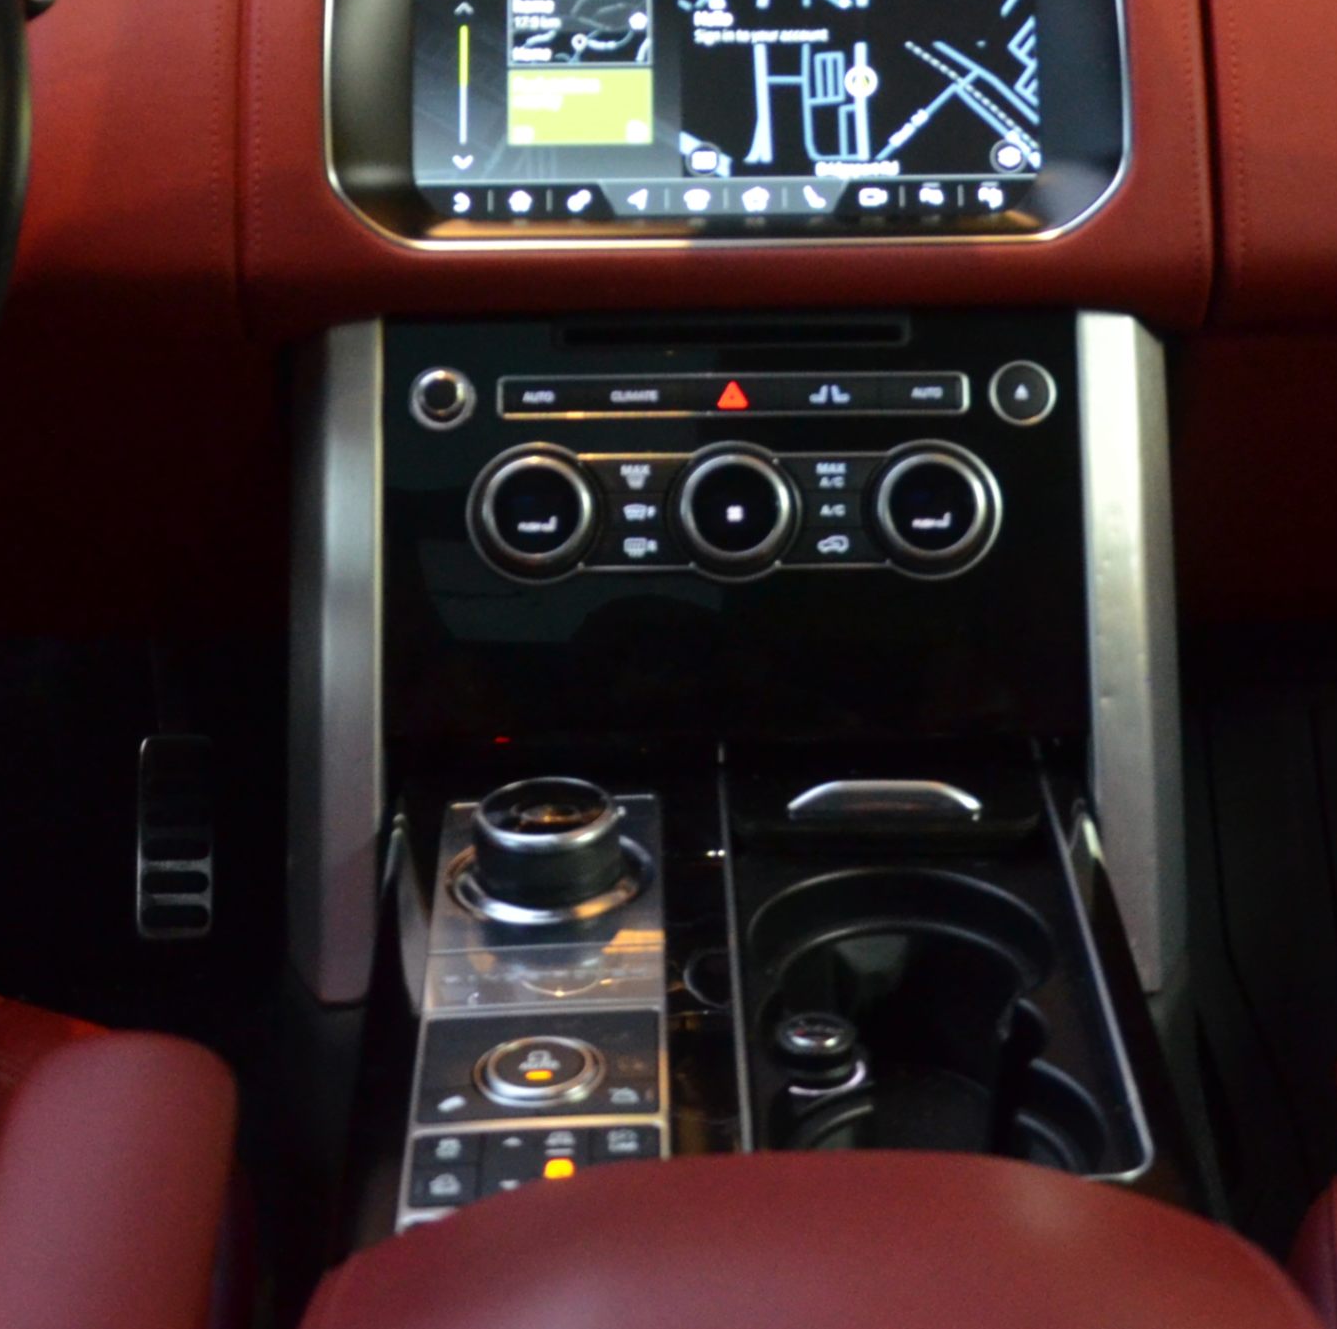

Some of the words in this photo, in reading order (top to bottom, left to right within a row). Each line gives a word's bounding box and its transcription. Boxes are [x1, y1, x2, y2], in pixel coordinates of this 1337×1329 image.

[779, 28, 829, 42] account
[522, 390, 555, 404] AUTO
[609, 389, 660, 403] CLIMATE
[911, 386, 944, 399] AUTO
[620, 464, 651, 476] MAX
[815, 462, 847, 475] MAX
[819, 475, 846, 488] A/C
[819, 503, 847, 517] A/C
